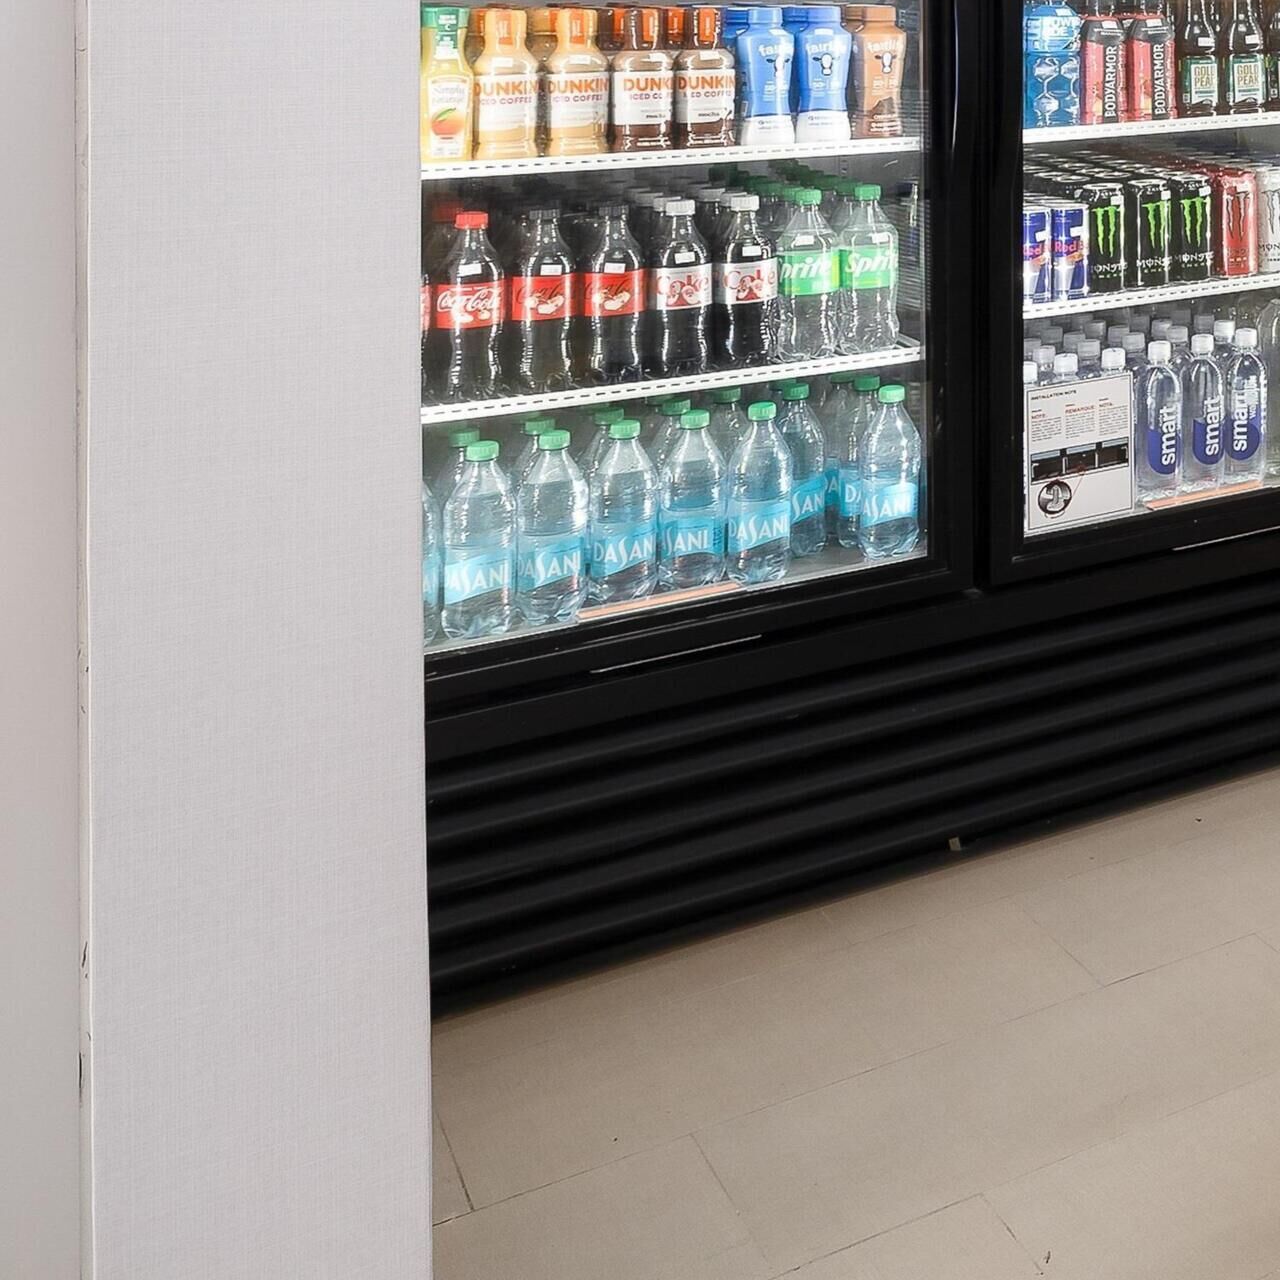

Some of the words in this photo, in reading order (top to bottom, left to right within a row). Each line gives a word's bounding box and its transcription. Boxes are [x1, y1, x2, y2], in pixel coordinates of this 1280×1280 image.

[679, 75, 736, 89] DUNKIN
[1104, 45, 1118, 118] BODYARMOR
[1153, 43, 1166, 115] BODYARMOR
[501, 97, 533, 105] COFFEE
[1054, 241, 1077, 253] Red
[1160, 404, 1176, 465] smart
[1204, 396, 1220, 457] smart
[729, 515, 791, 545] DASANI
[518, 551, 581, 584] DASANI
